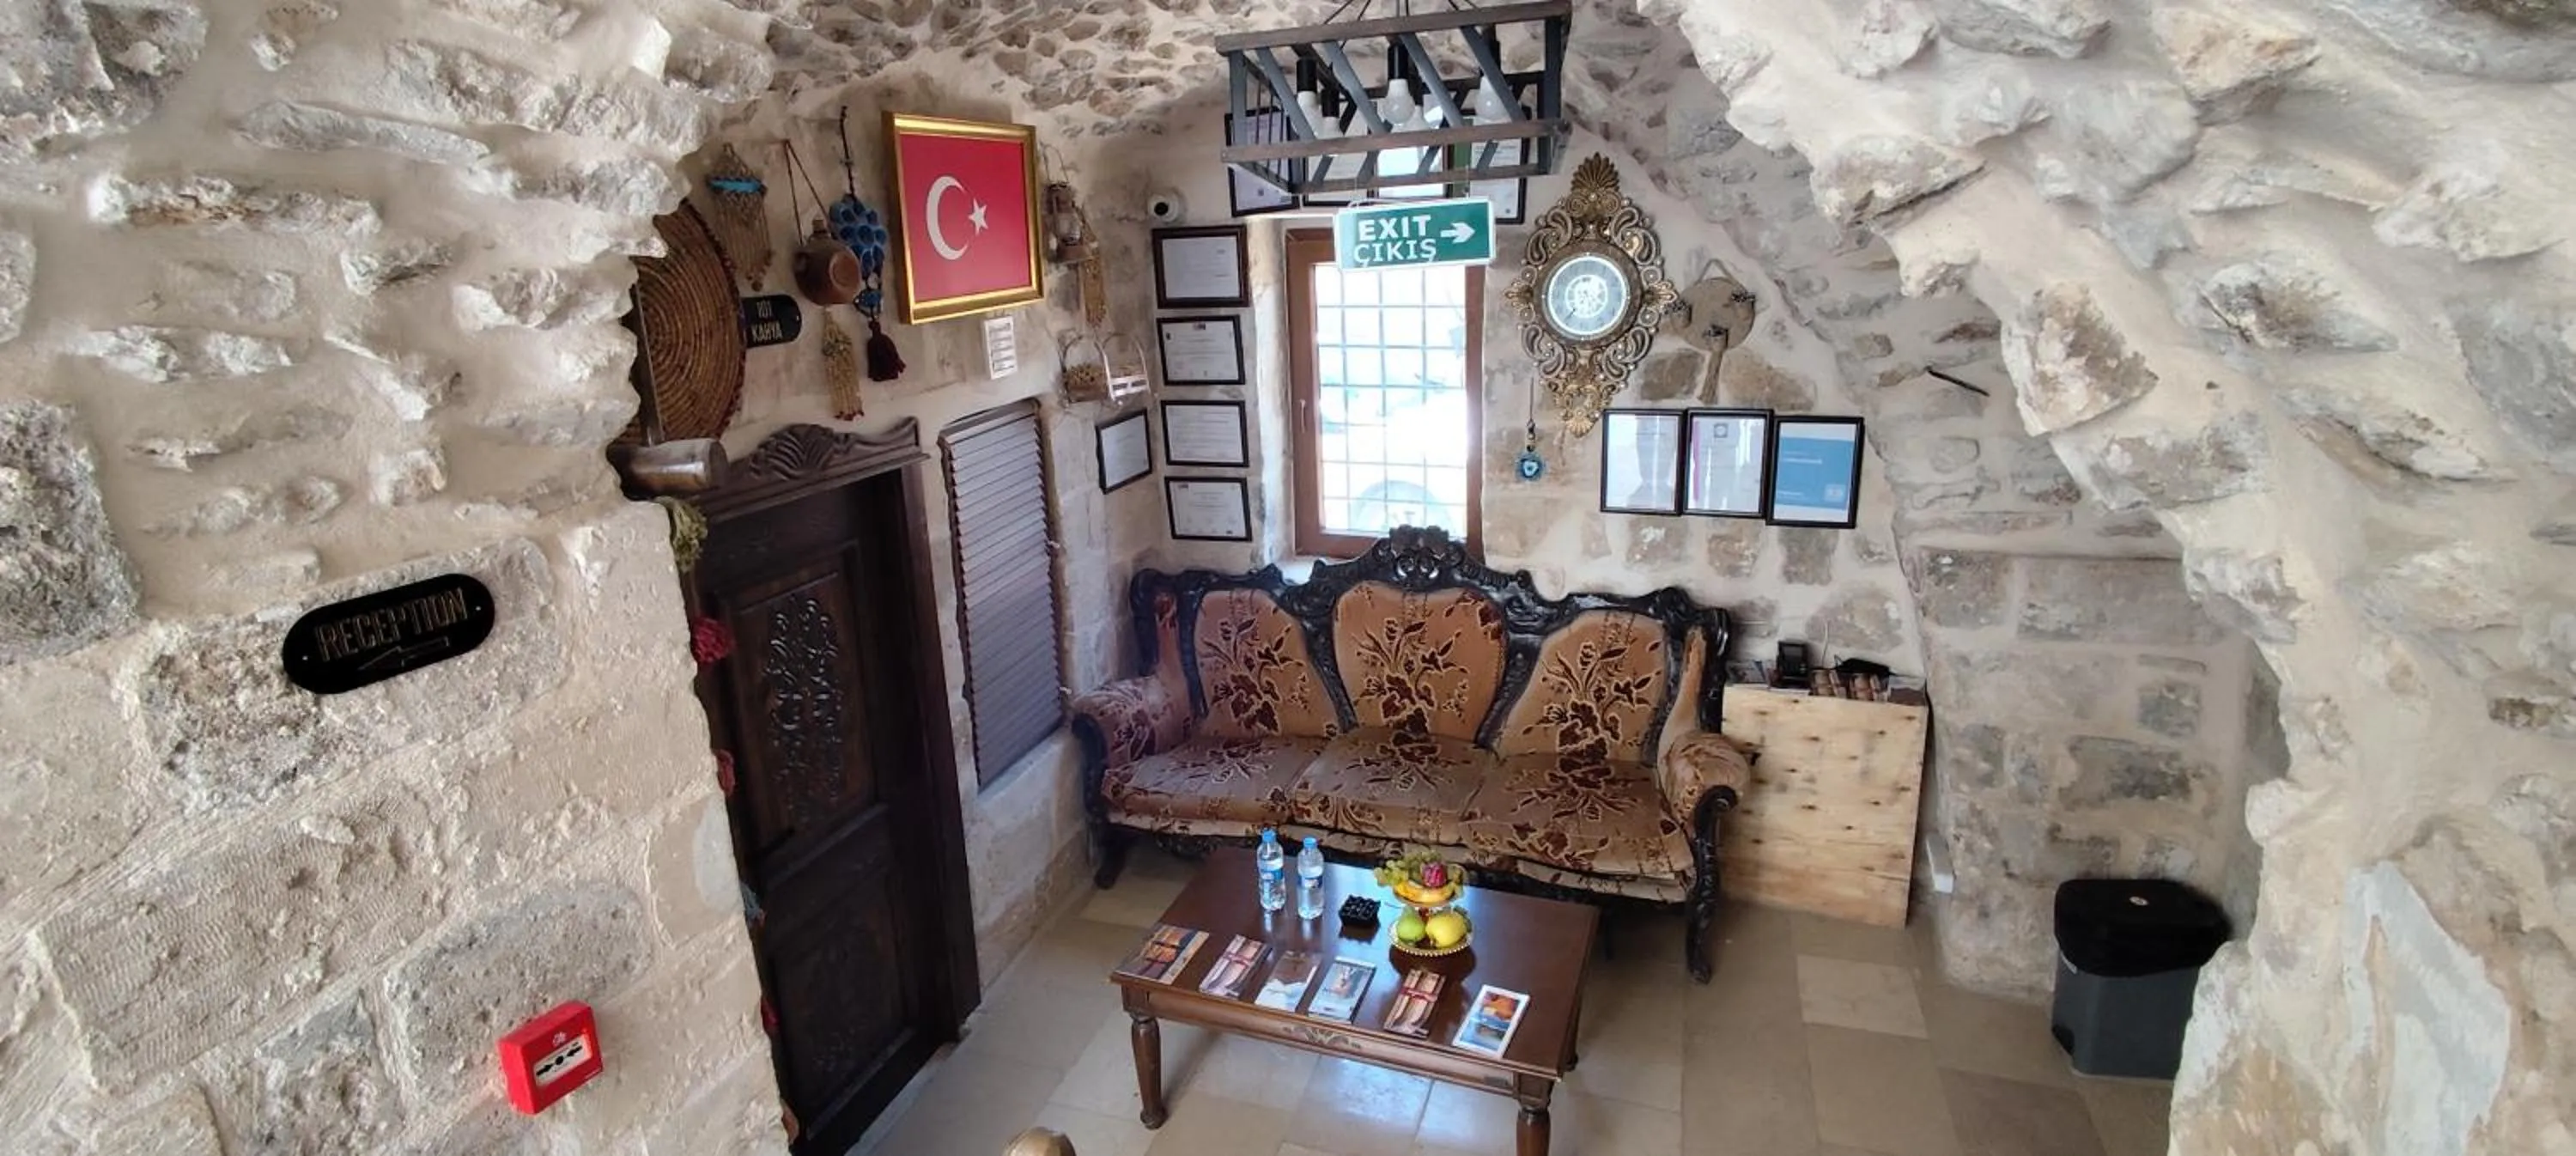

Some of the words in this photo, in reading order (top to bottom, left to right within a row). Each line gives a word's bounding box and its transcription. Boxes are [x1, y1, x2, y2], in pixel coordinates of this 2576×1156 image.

[1358, 215, 1431, 241] EXIT
[1354, 239, 1437, 268] ÇIKIŞ
[314, 587, 468, 662] RECEPTION
